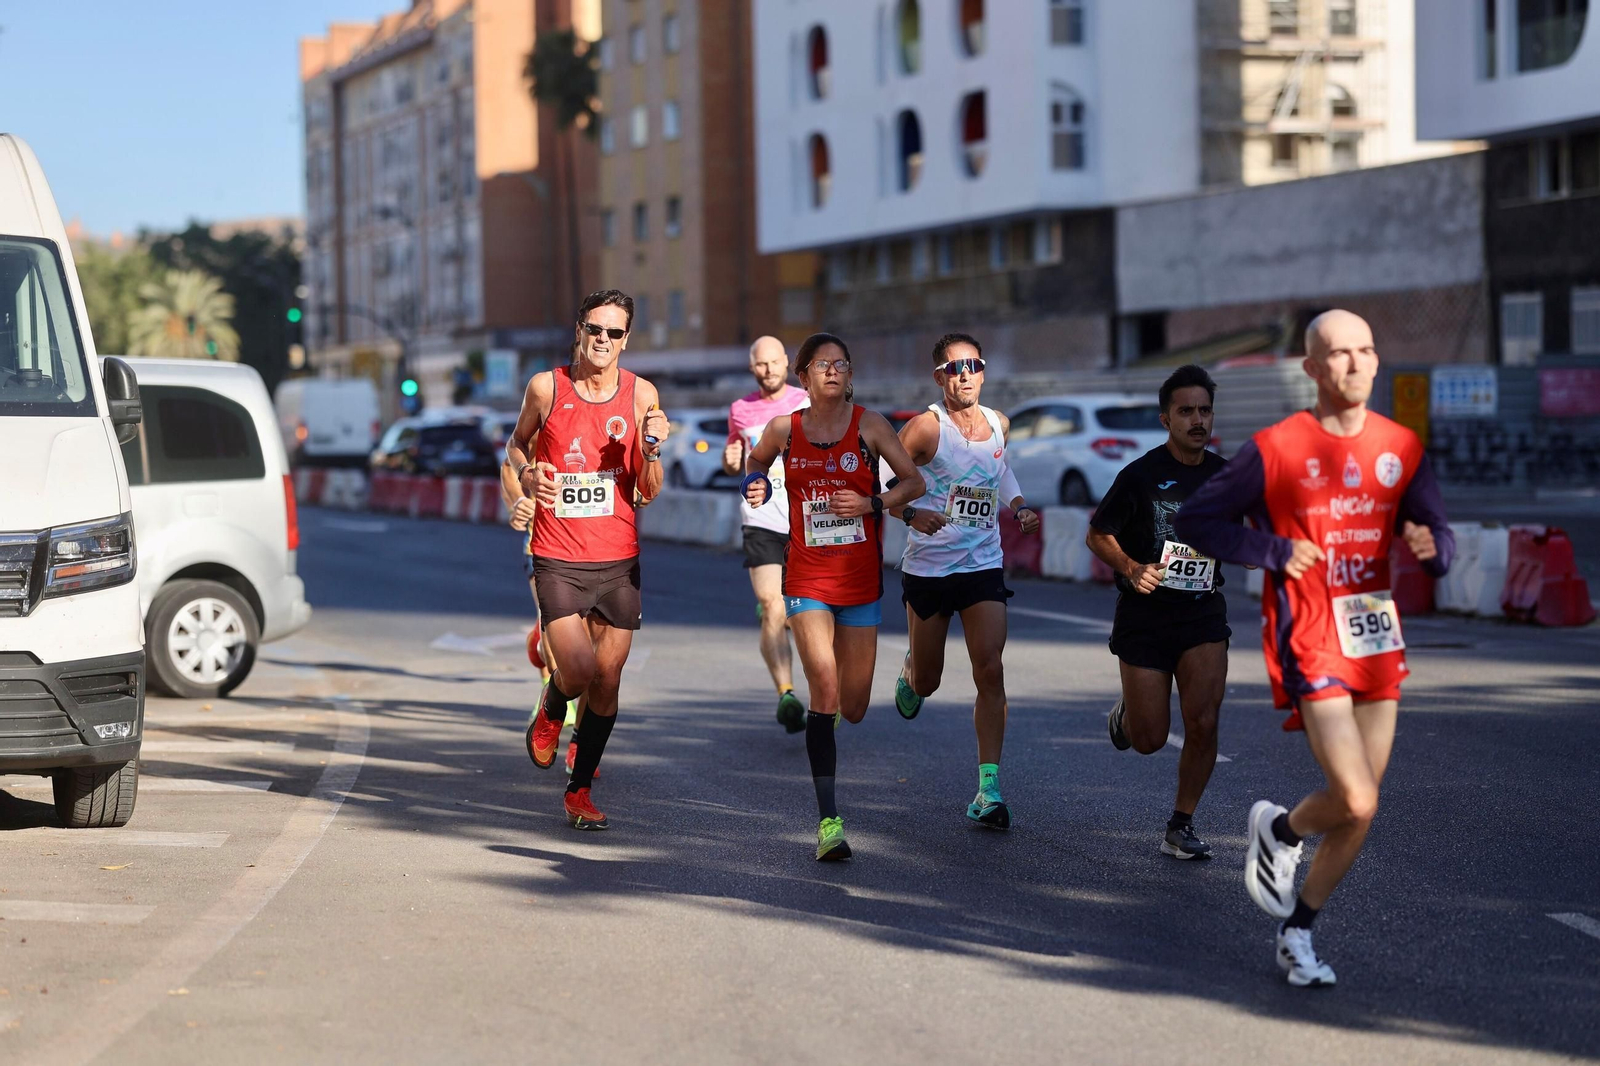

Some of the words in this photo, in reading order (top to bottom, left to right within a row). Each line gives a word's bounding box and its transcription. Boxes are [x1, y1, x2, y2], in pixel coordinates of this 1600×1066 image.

[562, 487, 606, 504] 609
[955, 499, 991, 517] 100
[813, 518, 855, 529] VELASCO
[1325, 528, 1382, 544] ATLETISMO
[819, 549, 854, 557] DENTAL
[1168, 559, 1209, 577] 467
[1349, 611, 1392, 637] 590
